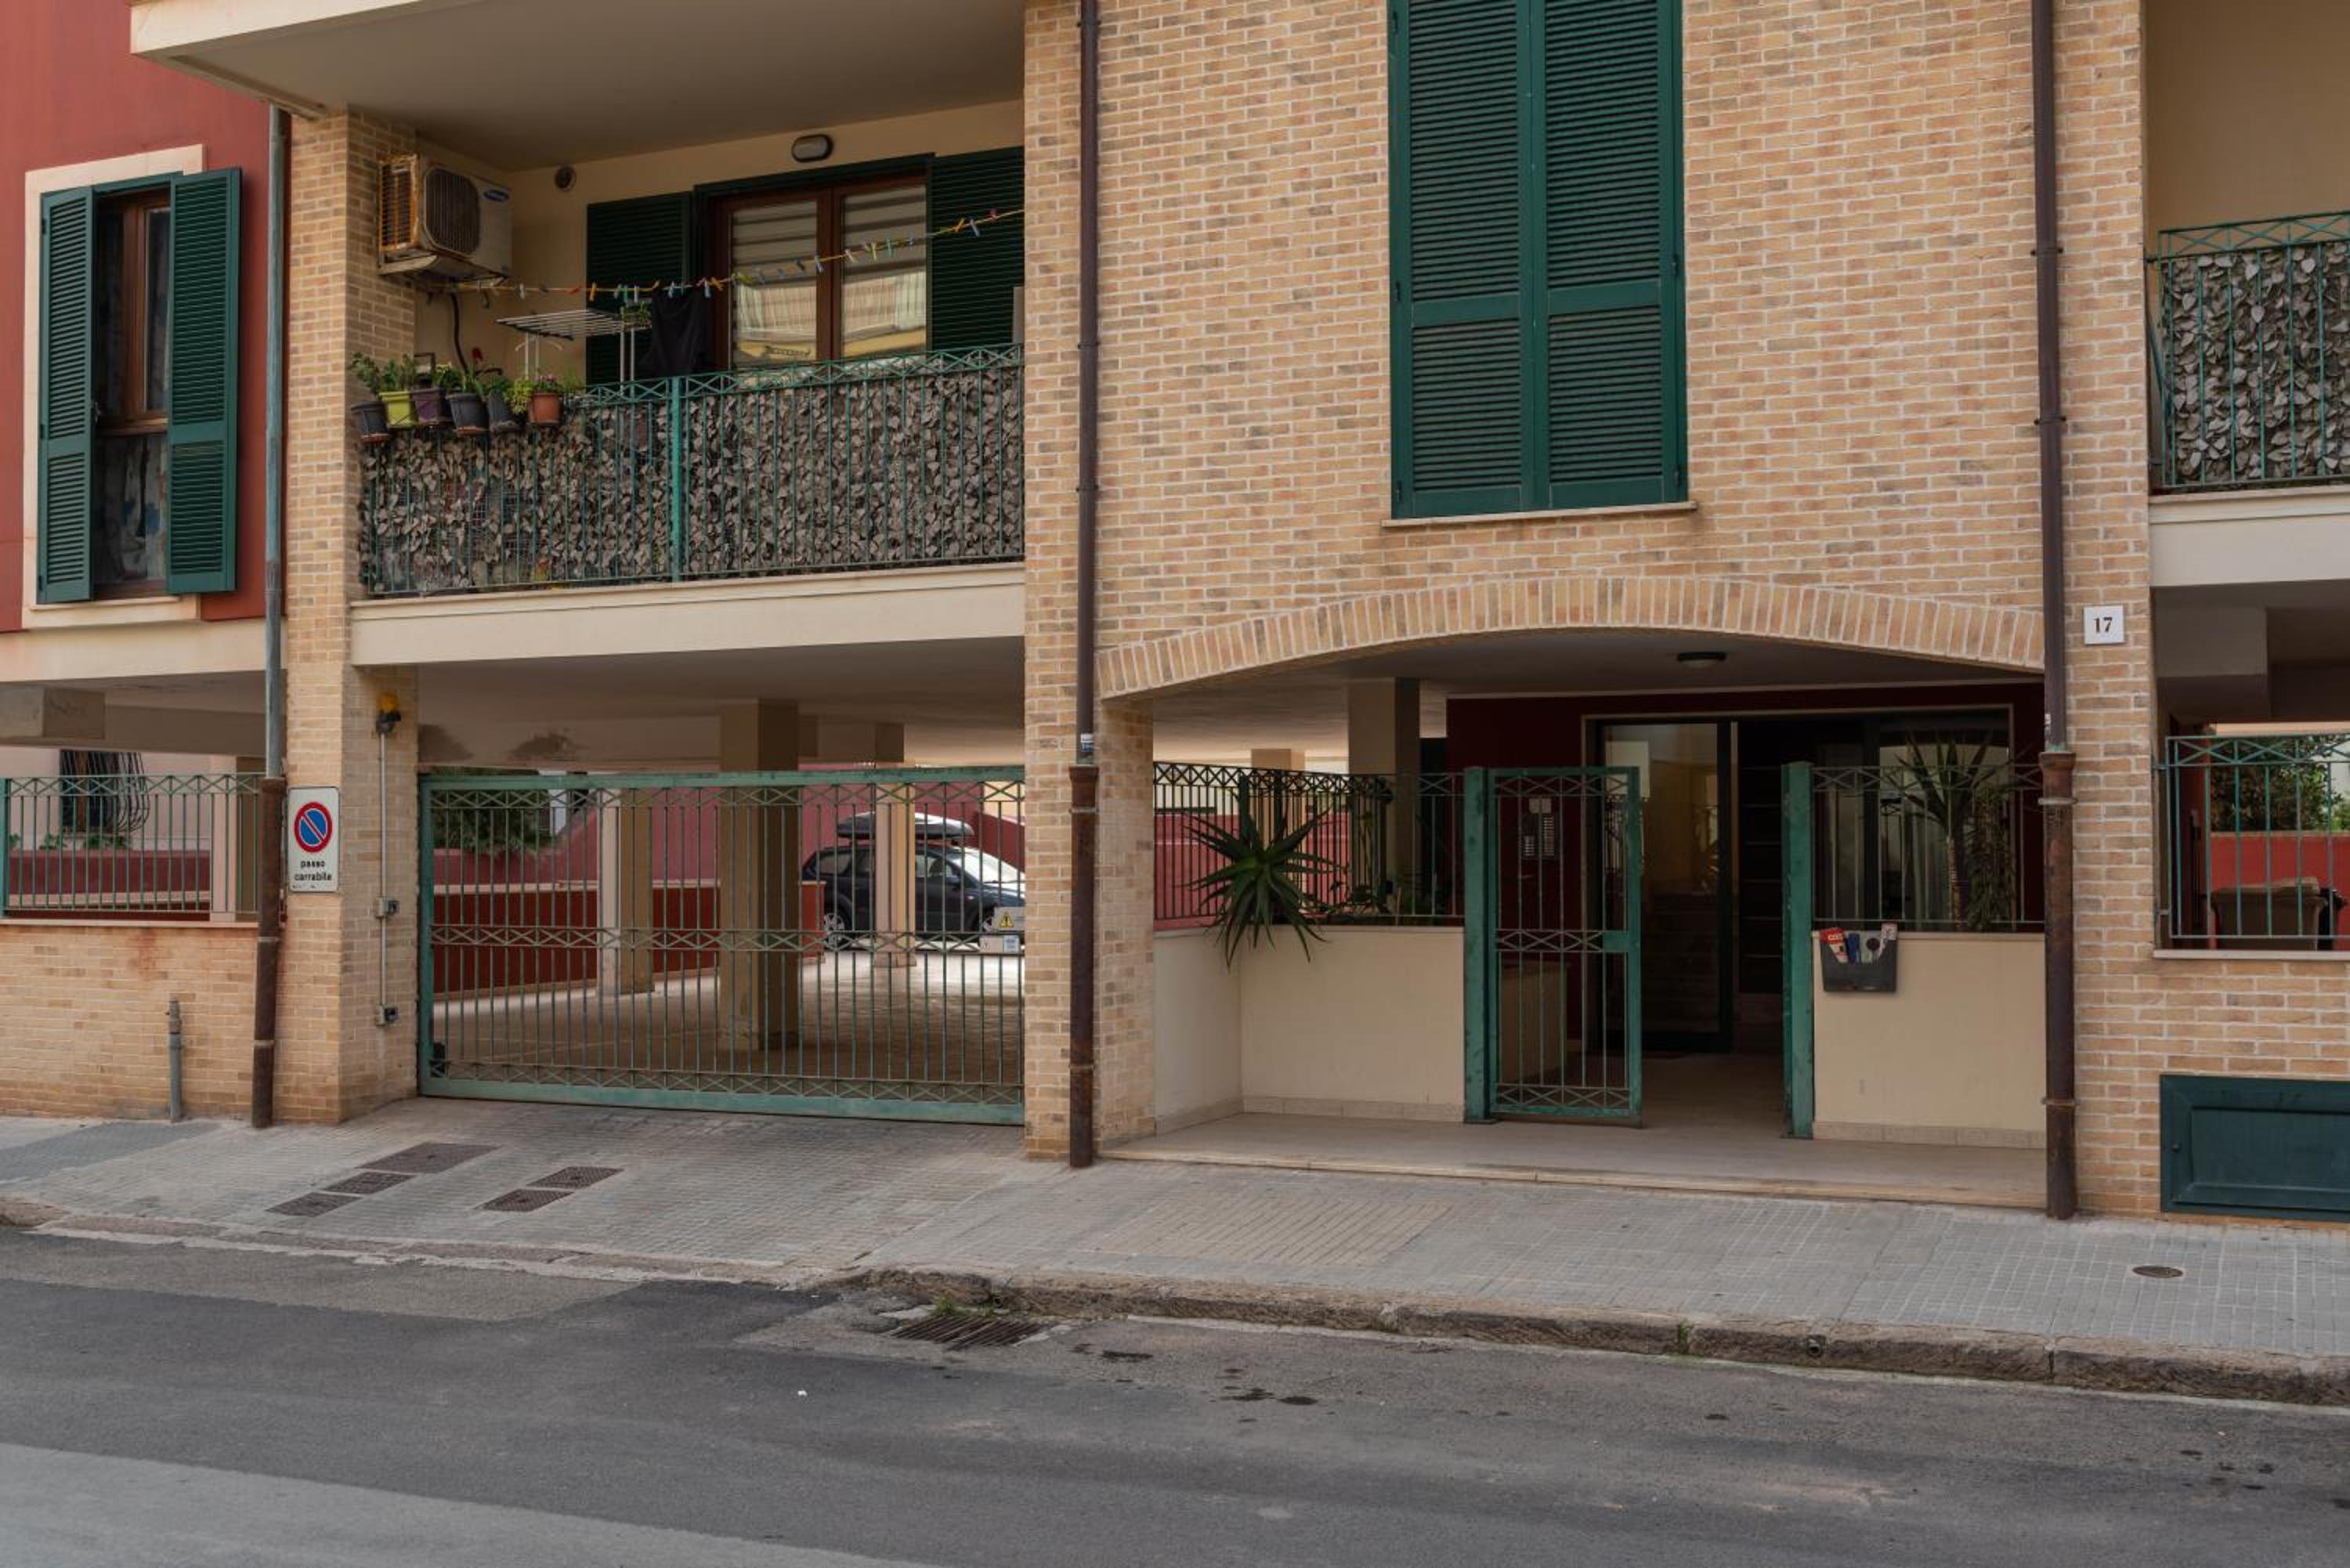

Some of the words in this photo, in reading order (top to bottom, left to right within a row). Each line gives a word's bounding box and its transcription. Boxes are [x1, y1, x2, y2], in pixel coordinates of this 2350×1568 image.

[2093, 616, 2113, 634] 17
[300, 861, 325, 869] passo
[294, 872, 332, 881] carrabile
